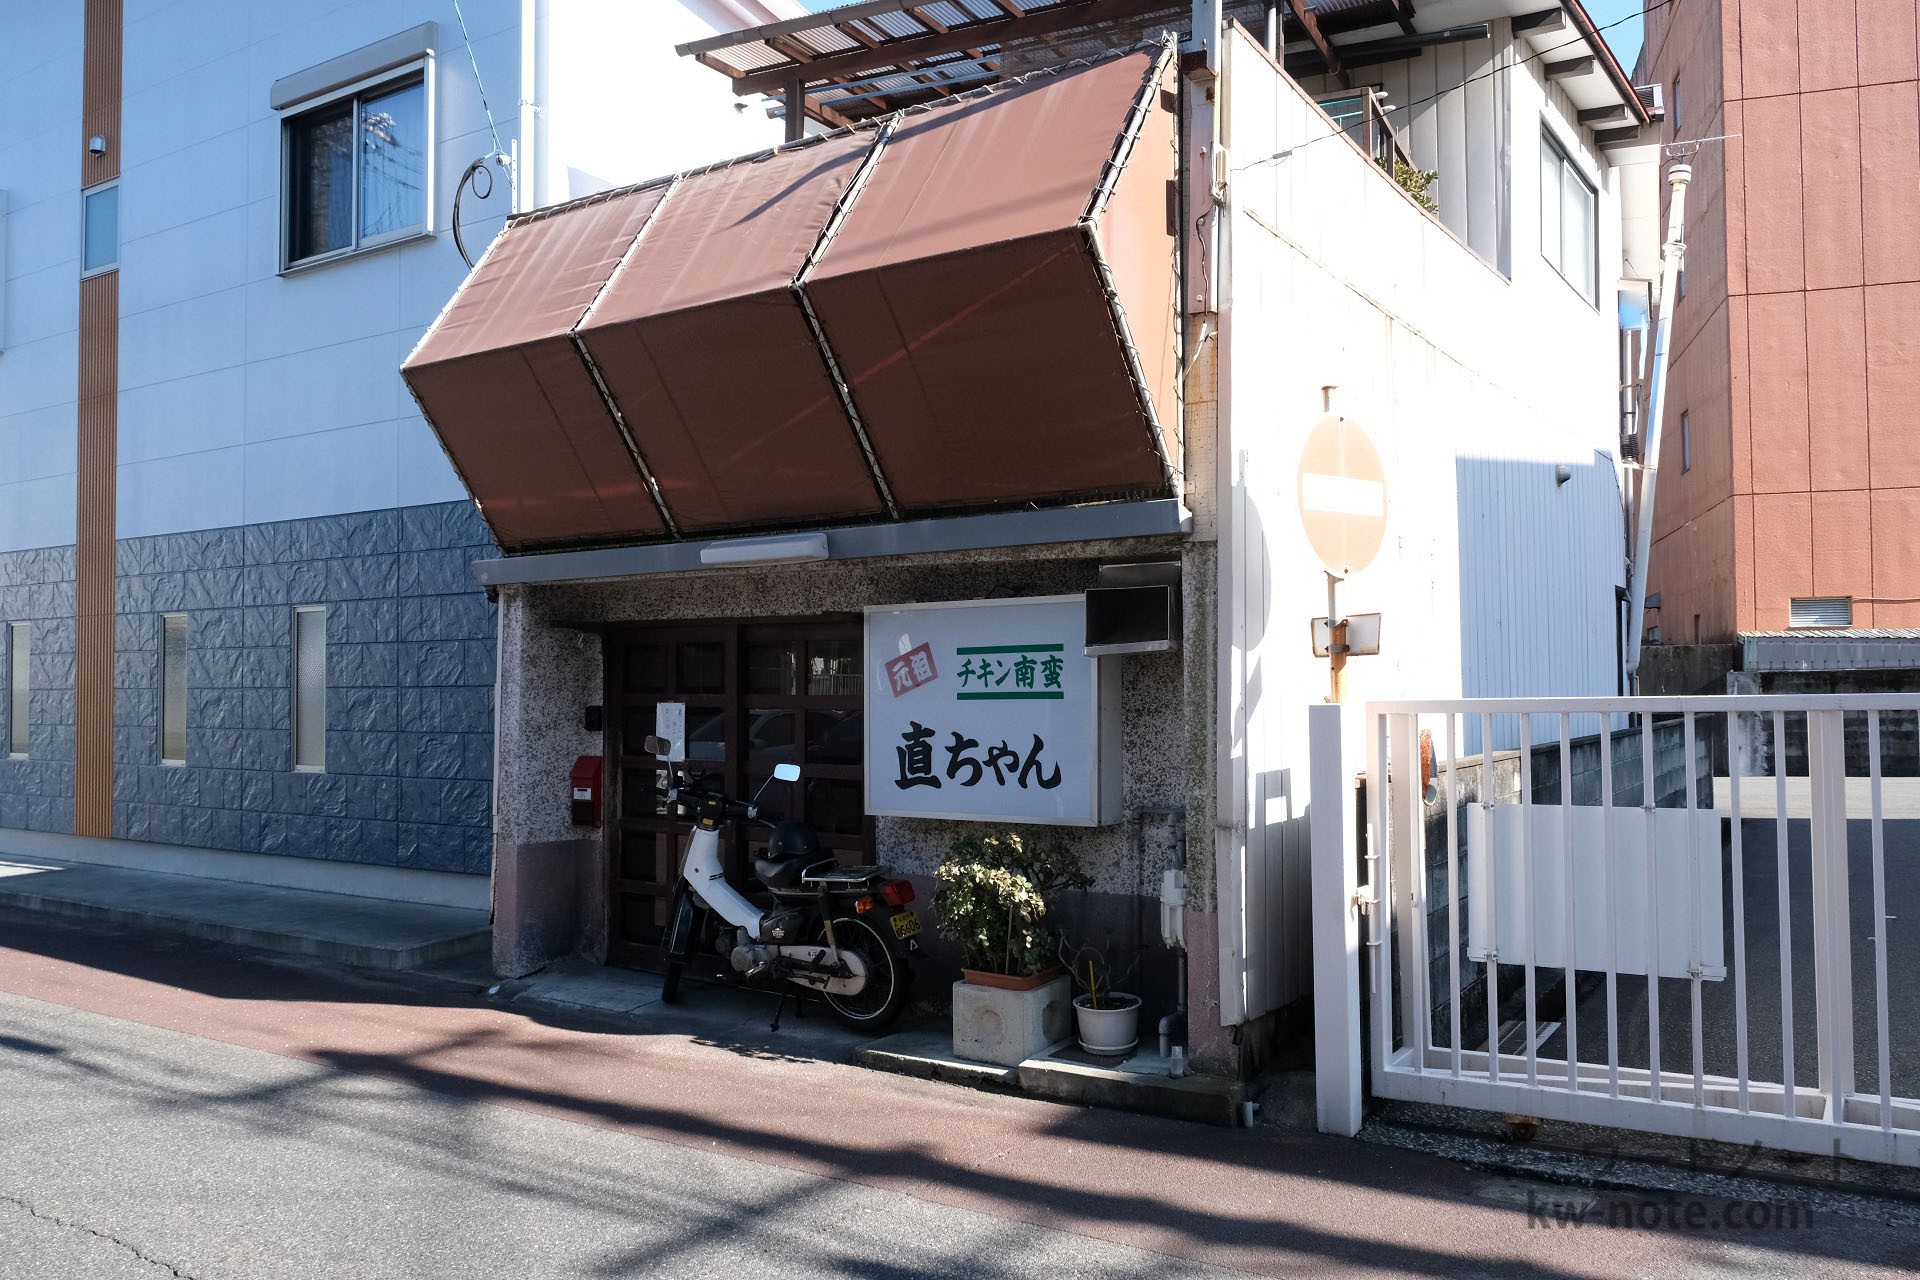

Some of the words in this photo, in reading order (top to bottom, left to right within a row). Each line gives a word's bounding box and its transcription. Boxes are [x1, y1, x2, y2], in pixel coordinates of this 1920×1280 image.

[892, 650, 933, 692] 元祖
[956, 654, 1064, 690] チキン南蛮
[894, 720, 1062, 790] 直ちゃん
